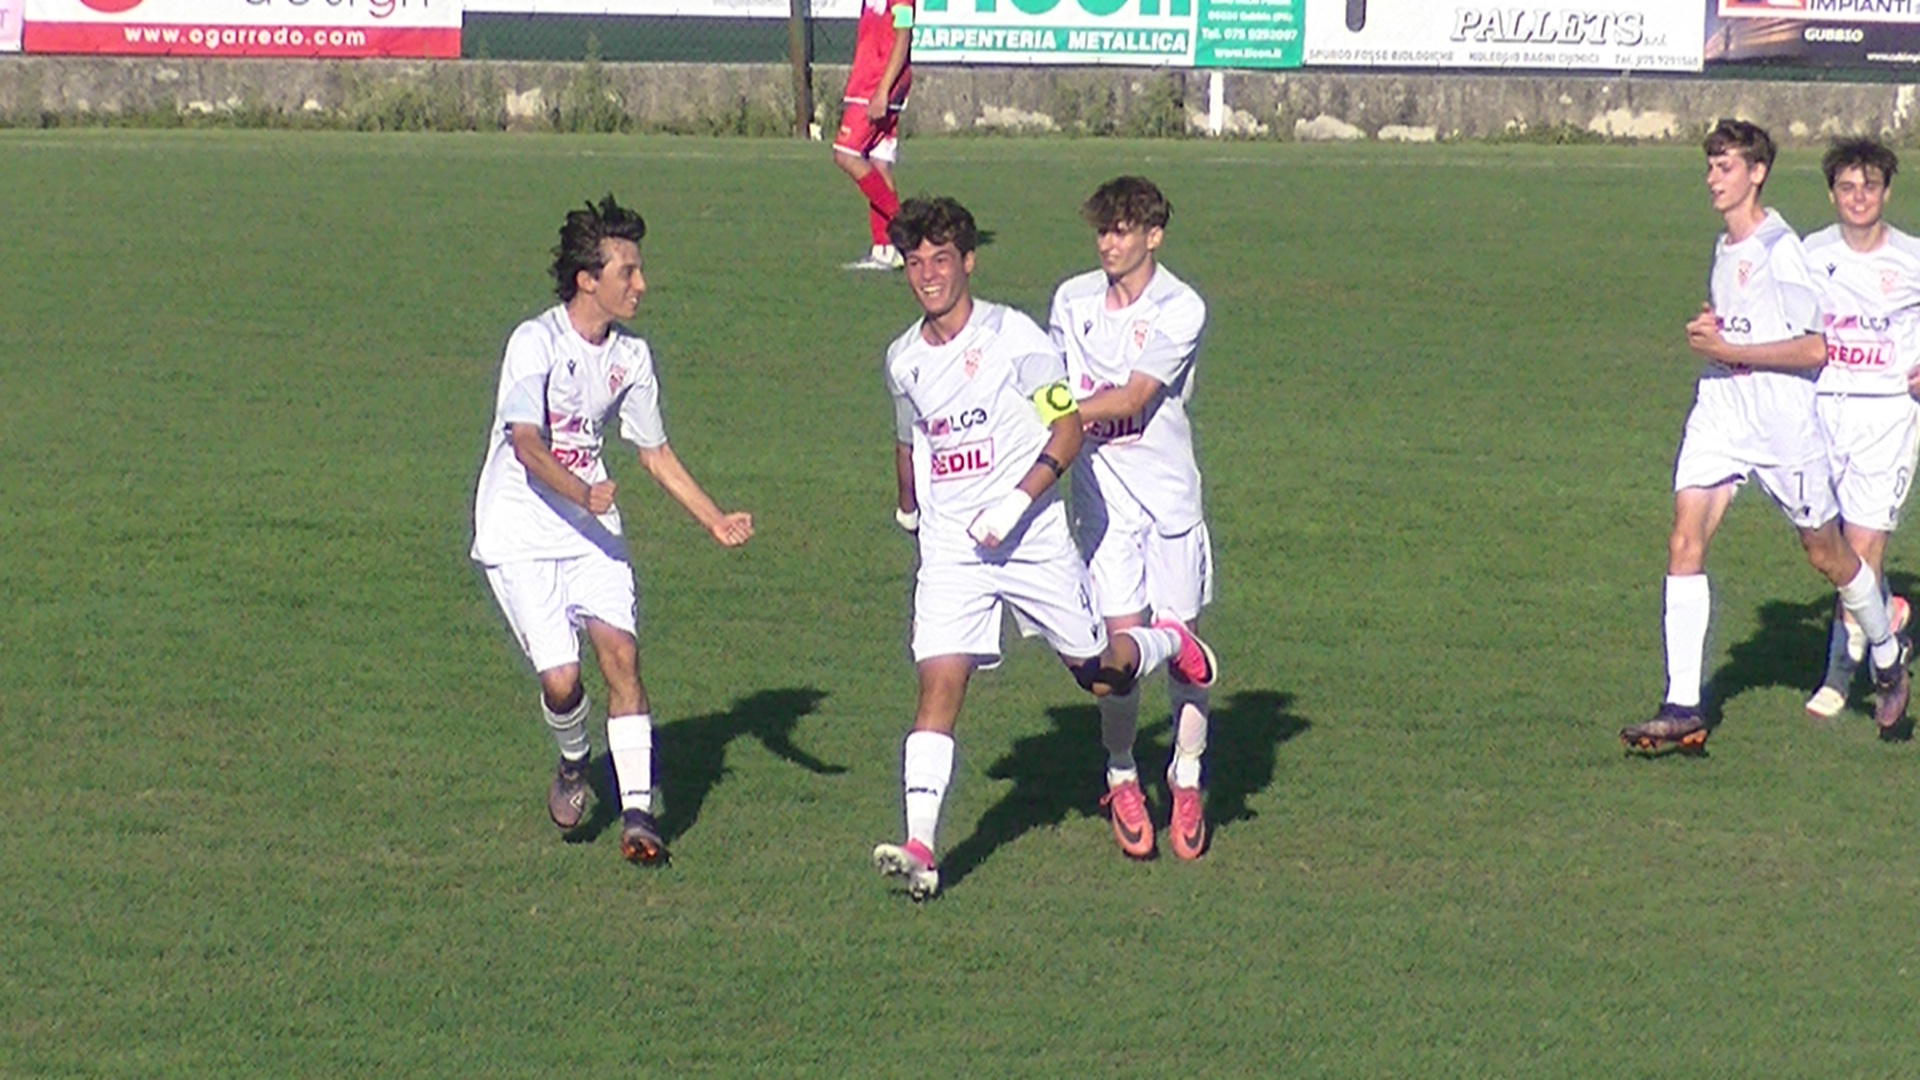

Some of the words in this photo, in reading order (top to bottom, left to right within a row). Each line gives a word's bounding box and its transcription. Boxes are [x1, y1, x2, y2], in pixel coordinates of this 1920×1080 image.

[123, 26, 366, 47] www.ogarredo.com
[912, 28, 1056, 50] CARPENTERIA
[1067, 31, 1187, 52] METALLICA
[1450, 8, 1644, 47] PALLETS
[1804, 28, 1864, 43] GUBBIO
[1046, 383, 1073, 412] C
[1792, 470, 1804, 501] 7
